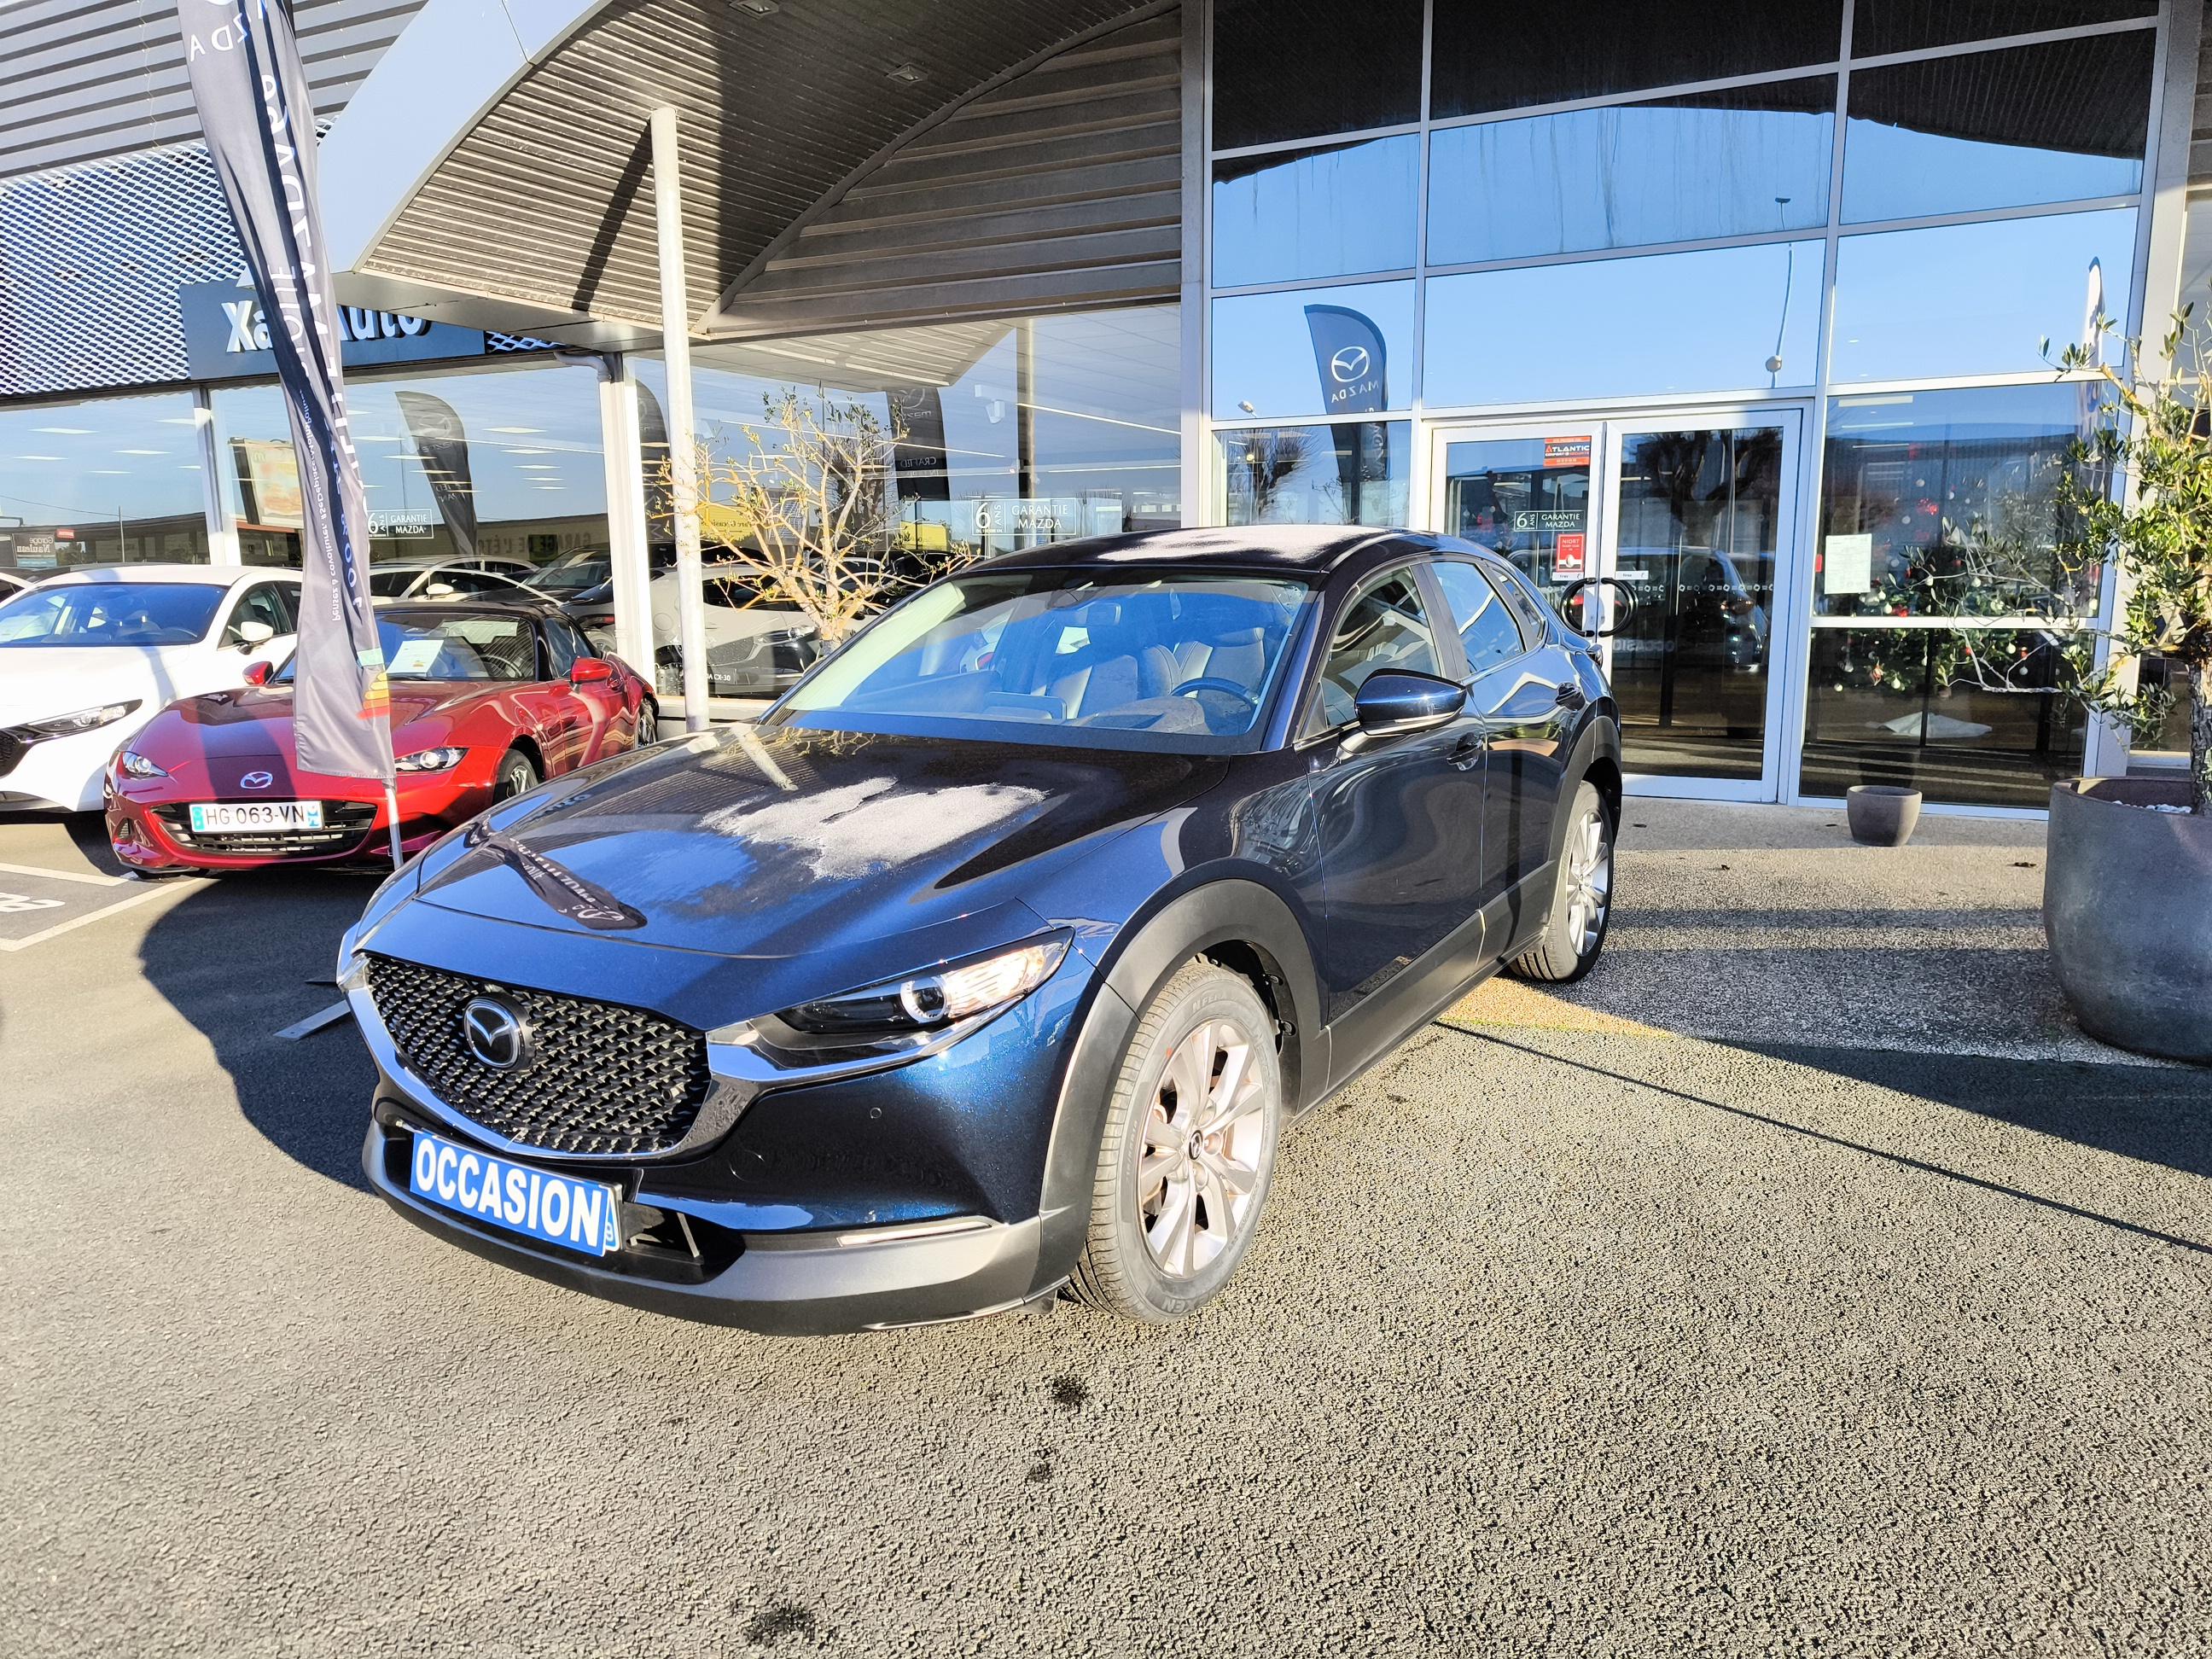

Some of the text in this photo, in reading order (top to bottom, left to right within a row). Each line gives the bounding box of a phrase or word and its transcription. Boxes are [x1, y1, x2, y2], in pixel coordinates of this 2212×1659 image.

[975, 503, 990, 528] 6
[994, 504, 1004, 525] ANS
[1011, 504, 1068, 515] GARANTIE
[368, 513, 378, 534] 6
[390, 514, 427, 523] GARANTIE
[1018, 518, 1062, 528] MAZDA
[1516, 513, 1528, 527] 6
[395, 525, 425, 534] MAZDA
[206, 807, 230, 826] HG
[416, 1138, 602, 1248] OCCASION
